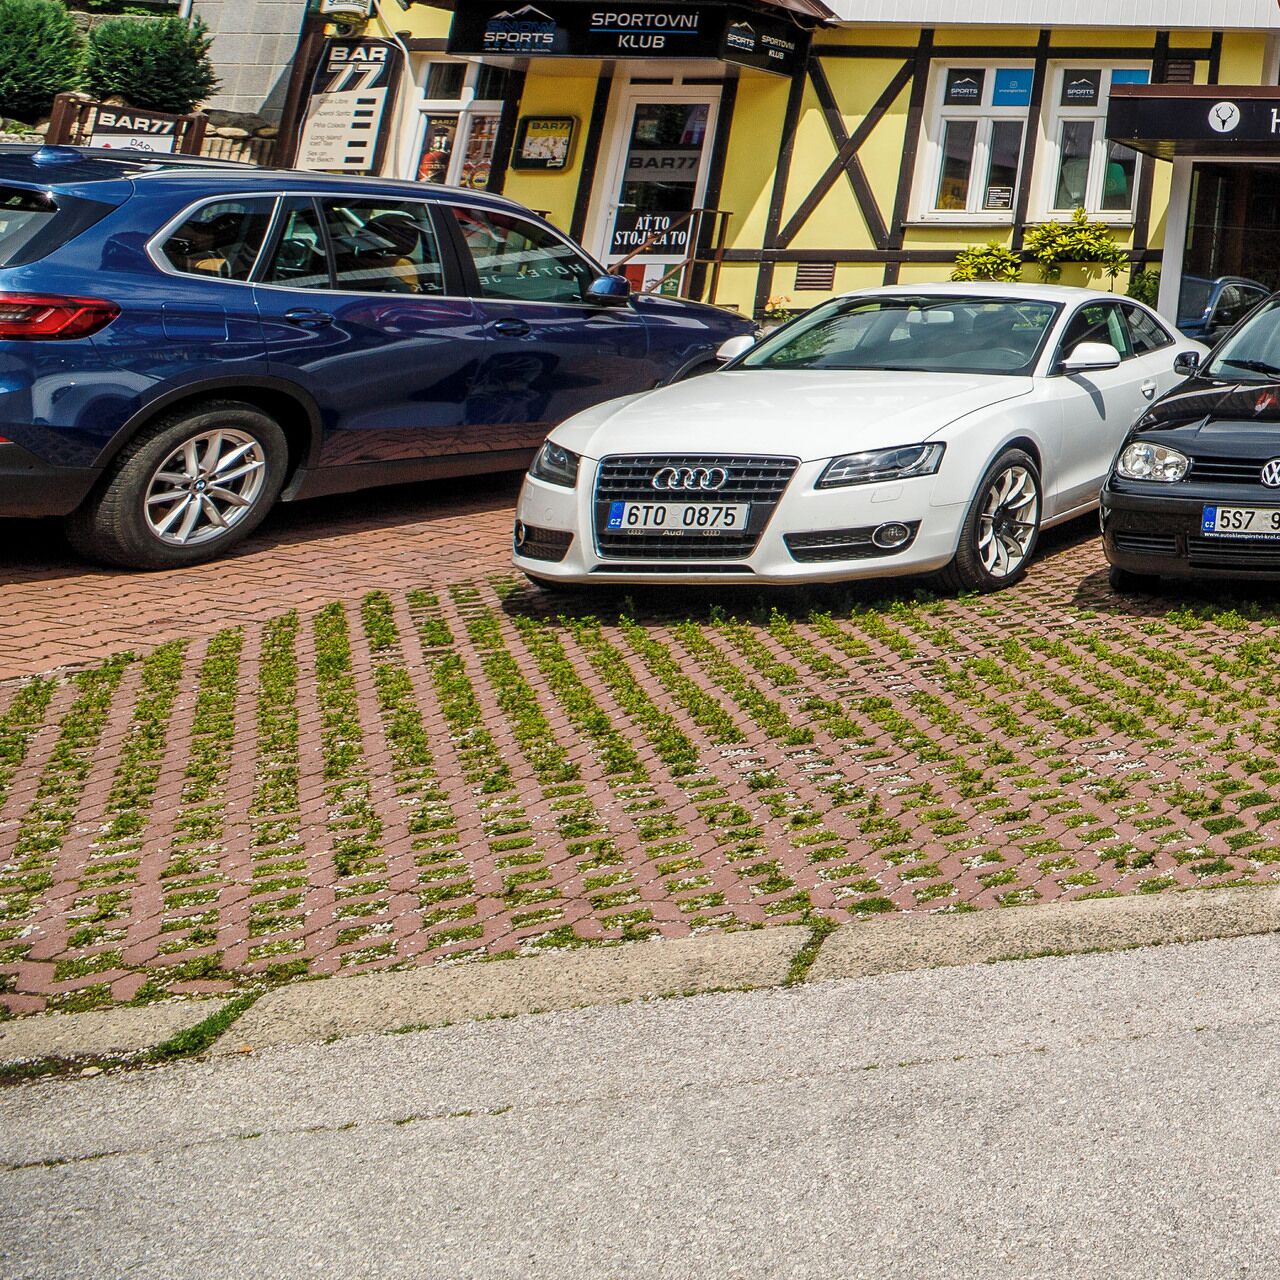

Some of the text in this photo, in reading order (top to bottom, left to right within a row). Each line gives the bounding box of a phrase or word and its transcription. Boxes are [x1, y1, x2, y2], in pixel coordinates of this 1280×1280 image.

[591, 11, 699, 28] SPORTOVNÍ
[482, 32, 554, 44] SPORTS
[617, 34, 666, 49] KLUB
[727, 33, 755, 47] SPORTS
[329, 47, 388, 61] BAR
[768, 48, 785, 60] KLUB
[325, 62, 385, 94] 77
[98, 112, 175, 134] BAR77
[531, 122, 571, 130] BAR77
[629, 157, 698, 169] BAR77
[635, 214, 670, 230] AŤ TO
[671, 231, 687, 245] TO
[627, 505, 667, 526] 6T0
[682, 506, 737, 526] 0875
[1220, 510, 1255, 530] 5S7
